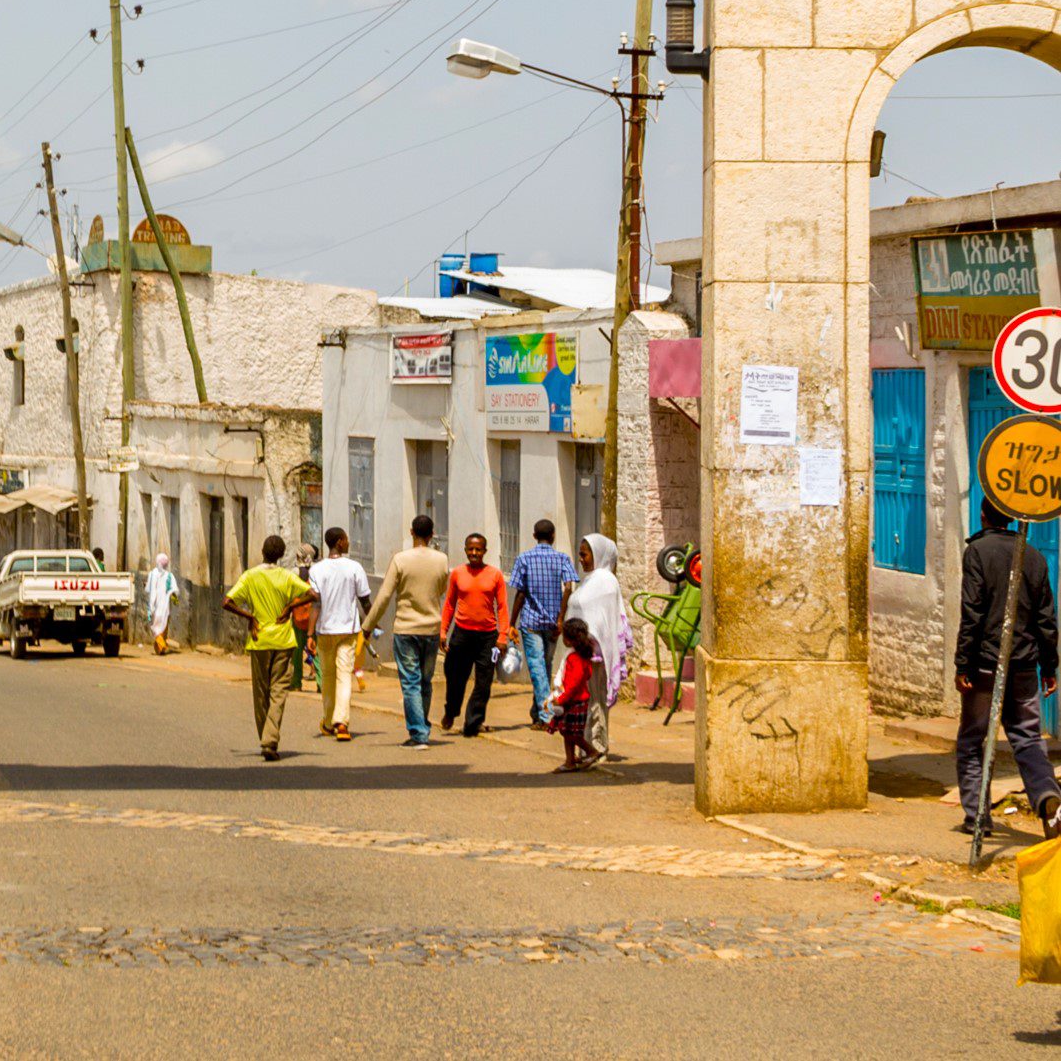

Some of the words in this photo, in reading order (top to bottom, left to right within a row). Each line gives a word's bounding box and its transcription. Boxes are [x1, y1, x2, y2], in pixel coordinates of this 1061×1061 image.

[136, 230, 186, 244] TRAING
[924, 305, 961, 339] DINI
[962, 312, 1014, 340] STATI
[504, 393, 540, 408] STATIONERY
[996, 467, 1061, 500] SLOW
[54, 579, 100, 591] ISUZU
